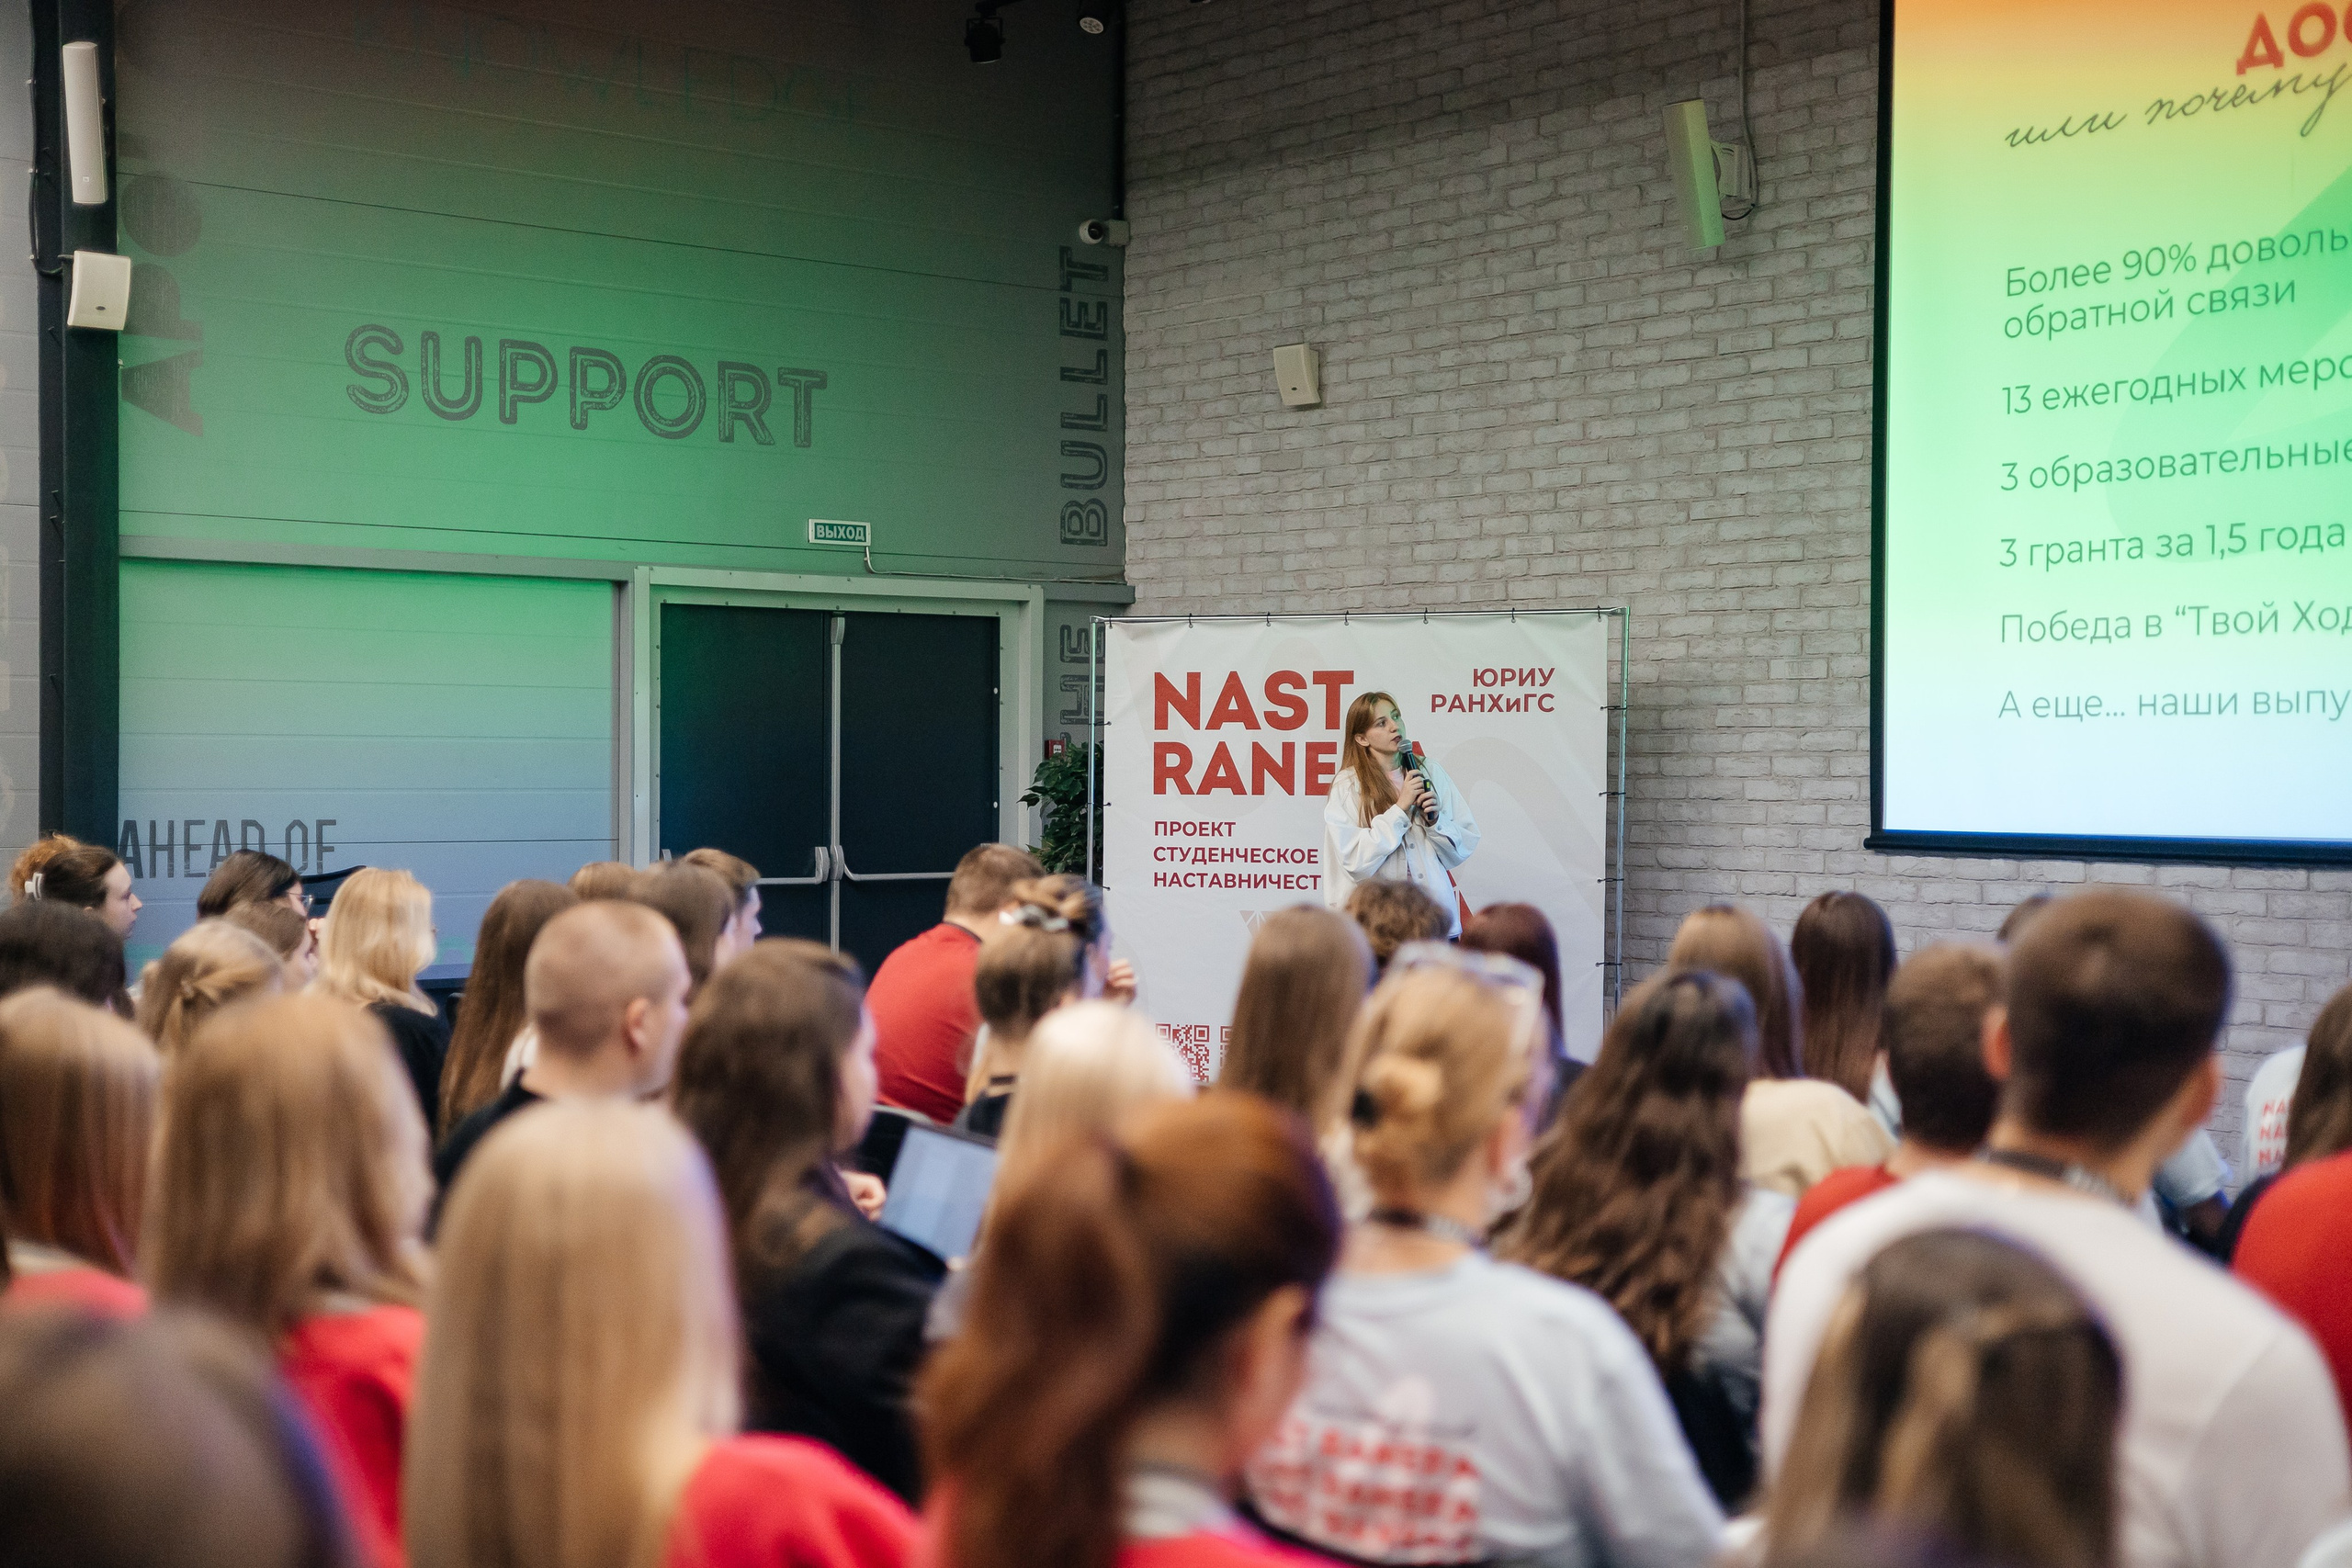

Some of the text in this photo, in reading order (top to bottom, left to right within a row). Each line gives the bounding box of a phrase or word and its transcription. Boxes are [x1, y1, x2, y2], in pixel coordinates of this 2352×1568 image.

[2235, 1, 2352, 76] ДО
[2005, 62, 2352, 148] или почему
[2007, 228, 2349, 297] Более 90% доволь
[2005, 280, 2296, 341] обратной связи
[345, 324, 827, 447] SUPPORT
[1059, 245, 1108, 547] BULLET
[2002, 385, 2032, 414] 13
[2042, 367, 2247, 411] ежегодных
[2000, 462, 2018, 491] 3
[816, 525, 865, 542] ВЫХОД
[1999, 522, 2346, 572] 3 гранта за 1,5 года
[2001, 609, 2132, 644] Победа
[2145, 615, 2163, 637] в
[1059, 624, 1105, 740] HE
[1154, 670, 1354, 730] NAST
[1473, 667, 1555, 687] ЮРИУ
[1430, 694, 1555, 713] РАНХиГС
[1998, 689, 2351, 722] А еще... наши выпу
[1154, 740, 1426, 795] RANE
[285, 818, 336, 874] OF
[1154, 821, 1236, 837] ПРОЕКТ
[1153, 846, 1319, 865] СТУДЕНЧЕСКОЕ
[1153, 872, 1321, 890] НАСТАВНИЧЕСТ
